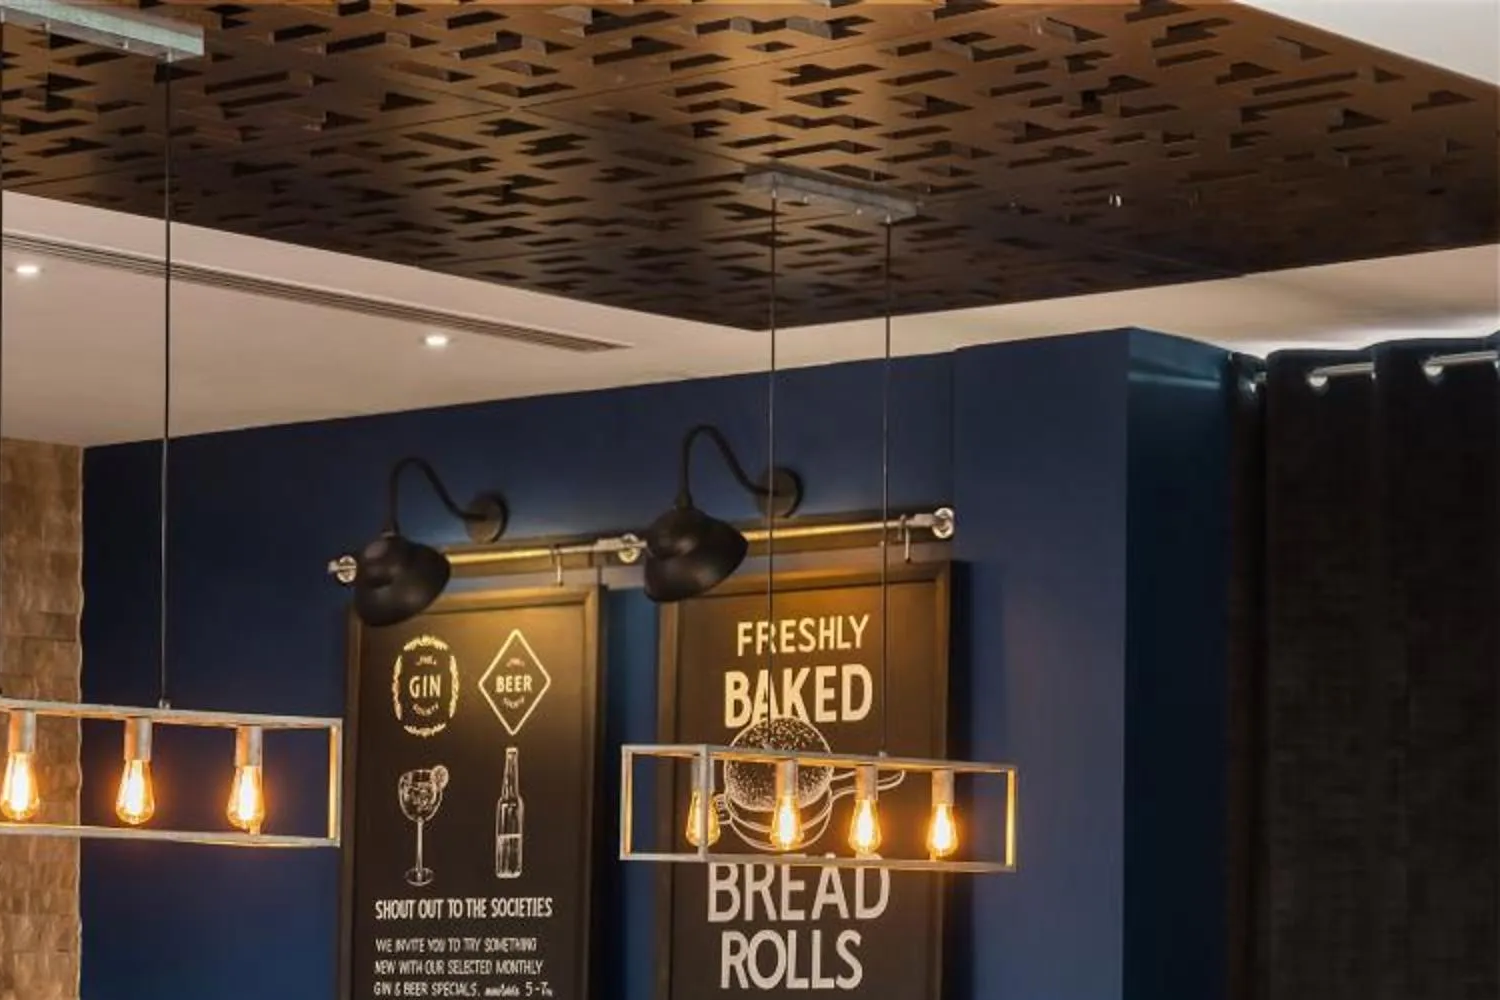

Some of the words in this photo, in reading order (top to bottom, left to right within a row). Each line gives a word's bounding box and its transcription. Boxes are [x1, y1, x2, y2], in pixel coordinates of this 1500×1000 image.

[736, 614, 870, 657] FRESHLY
[409, 674, 441, 699] GIN
[495, 675, 533, 693] BEER
[724, 663, 874, 728] BAKED
[707, 852, 891, 923] BREAD
[375, 899, 416, 920] SHOUT
[418, 899, 444, 919] OUT
[448, 898, 463, 919] TO
[467, 898, 486, 918] THE
[491, 897, 553, 918] SOCIETIES
[375, 938, 392, 953] WE
[395, 938, 425, 953] INVITE
[427, 938, 446, 953] YOU
[448, 938, 461, 953] TO
[463, 938, 481, 953] TRY
[484, 937, 537, 952] SOMETHING
[374, 960, 396, 975] NEW
[398, 960, 422, 975] WITH
[425, 960, 445, 975] OUR
[447, 960, 492, 975] SELECTED
[495, 960, 544, 975] MONTHLY
[720, 929, 864, 990] ROLLS
[373, 981, 392, 996] GIN
[403, 981, 428, 996] BEER
